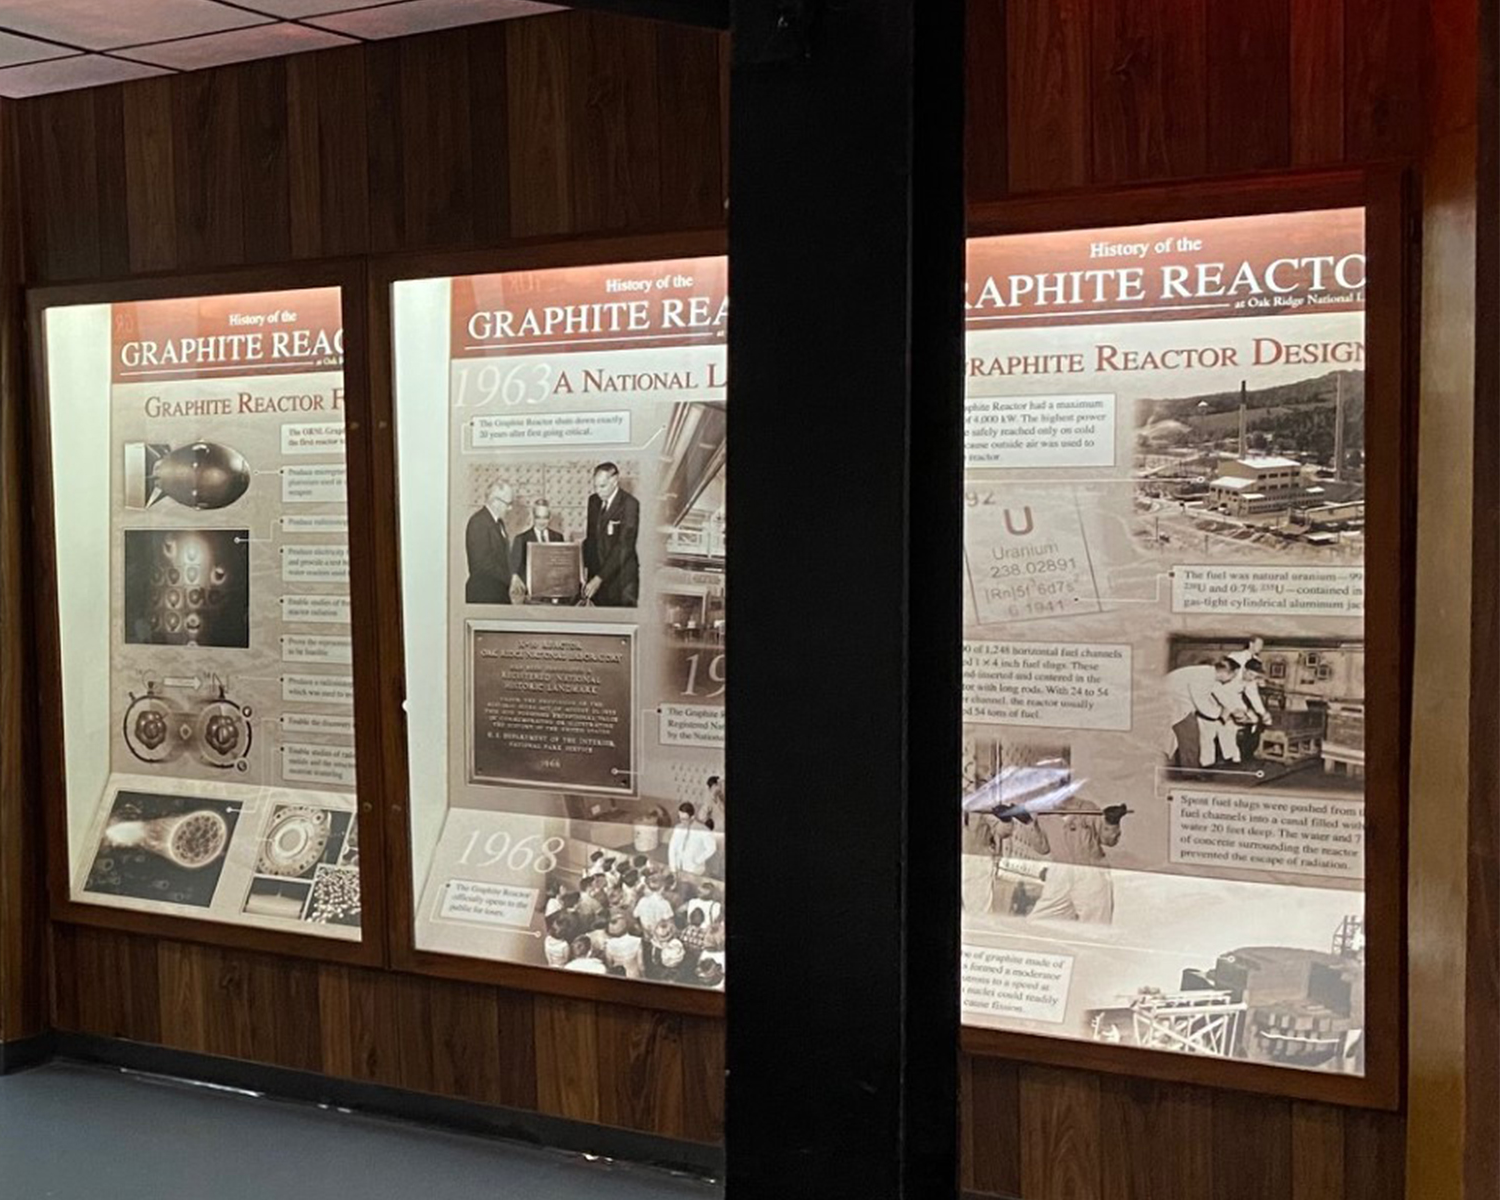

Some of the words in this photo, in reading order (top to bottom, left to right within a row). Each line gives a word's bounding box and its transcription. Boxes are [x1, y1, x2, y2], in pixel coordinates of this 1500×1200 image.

[1090, 242, 1149, 258] History
[1155, 238, 1174, 252] of
[1177, 237, 1202, 251] the
[606, 278, 652, 294] History
[656, 276, 671, 289] of
[673, 274, 693, 288] the
[1235, 300, 1245, 308] at
[1248, 298, 1270, 307] Oak
[1274, 296, 1304, 308] Ridge
[1307, 293, 1353, 304] National
[229, 312, 265, 326] History
[267, 312, 280, 323] of
[281, 310, 297, 322] the
[468, 300, 650, 340] GRAPHITE
[121, 333, 262, 367] GRAPHITE
[966, 354, 1084, 377] RAPHITE
[1094, 344, 1238, 372] REACTOR
[453, 363, 552, 407] 1963
[553, 371, 574, 395] A
[583, 369, 698, 393] NATIONAL
[144, 396, 232, 418] GRAPHITE
[238, 392, 324, 414] REACTOR
[993, 401, 1027, 411] Reactor
[1029, 401, 1046, 409] had
[1056, 400, 1103, 409] maximum
[479, 418, 492, 428] The
[494, 417, 525, 428] Graphite
[526, 417, 553, 427] Reactor
[555, 416, 573, 426] shut
[575, 415, 596, 425] down
[597, 415, 623, 427] exactly
[1023, 414, 1038, 423] The
[1040, 414, 1074, 423] highest
[1076, 414, 1106, 422] power
[972, 427, 999, 438] safely
[1001, 427, 1035, 436] reached
[1038, 426, 1058, 436] only
[1075, 426, 1095, 434] cold
[991, 440, 1023, 449] outside
[1026, 439, 1038, 448] air
[1061, 439, 1083, 447] used
[1085, 439, 1095, 447] to
[1004, 506, 1034, 536] U
[992, 543, 1059, 560] Uranium
[1184, 571, 1202, 580] The
[1206, 571, 1226, 580] fuel
[1252, 572, 1289, 581] natural
[1209, 584, 1227, 593] and
[1184, 597, 1227, 609] gas-tight
[1230, 598, 1287, 610] cylindrical
[1289, 600, 1344, 609] aluminum
[668, 708, 683, 716] The
[1181, 795, 1209, 807] Spent
[1212, 797, 1231, 808] fuel
[1234, 799, 1260, 811] slugs
[1263, 802, 1287, 811] were
[1290, 804, 1328, 815] pushed
[1330, 806, 1356, 816] from
[1180, 808, 1199, 818] fuel
[1202, 810, 1247, 822] channels
[1249, 814, 1269, 824] into
[1281, 816, 1308, 826] canal
[1311, 818, 1339, 829] filled
[1181, 823, 1207, 831] water
[1210, 823, 1224, 833] 20
[1226, 825, 1245, 835] feet
[1248, 826, 1275, 838] deep.
[1278, 829, 1297, 838] The
[1301, 831, 1329, 842] water
[1332, 832, 1352, 843] and
[458, 829, 566, 874] 1968
[1180, 835, 1191, 844] of
[1194, 837, 1235, 847] concrete
[1238, 840, 1300, 854] surrounding
[1302, 843, 1319, 854] the
[1321, 846, 1358, 857] reactor
[1180, 849, 1229, 861] prevented
[1232, 851, 1247, 861] the
[1250, 854, 1284, 866] escape
[1287, 856, 1298, 866] of
[1301, 858, 1349, 870] radiation.
